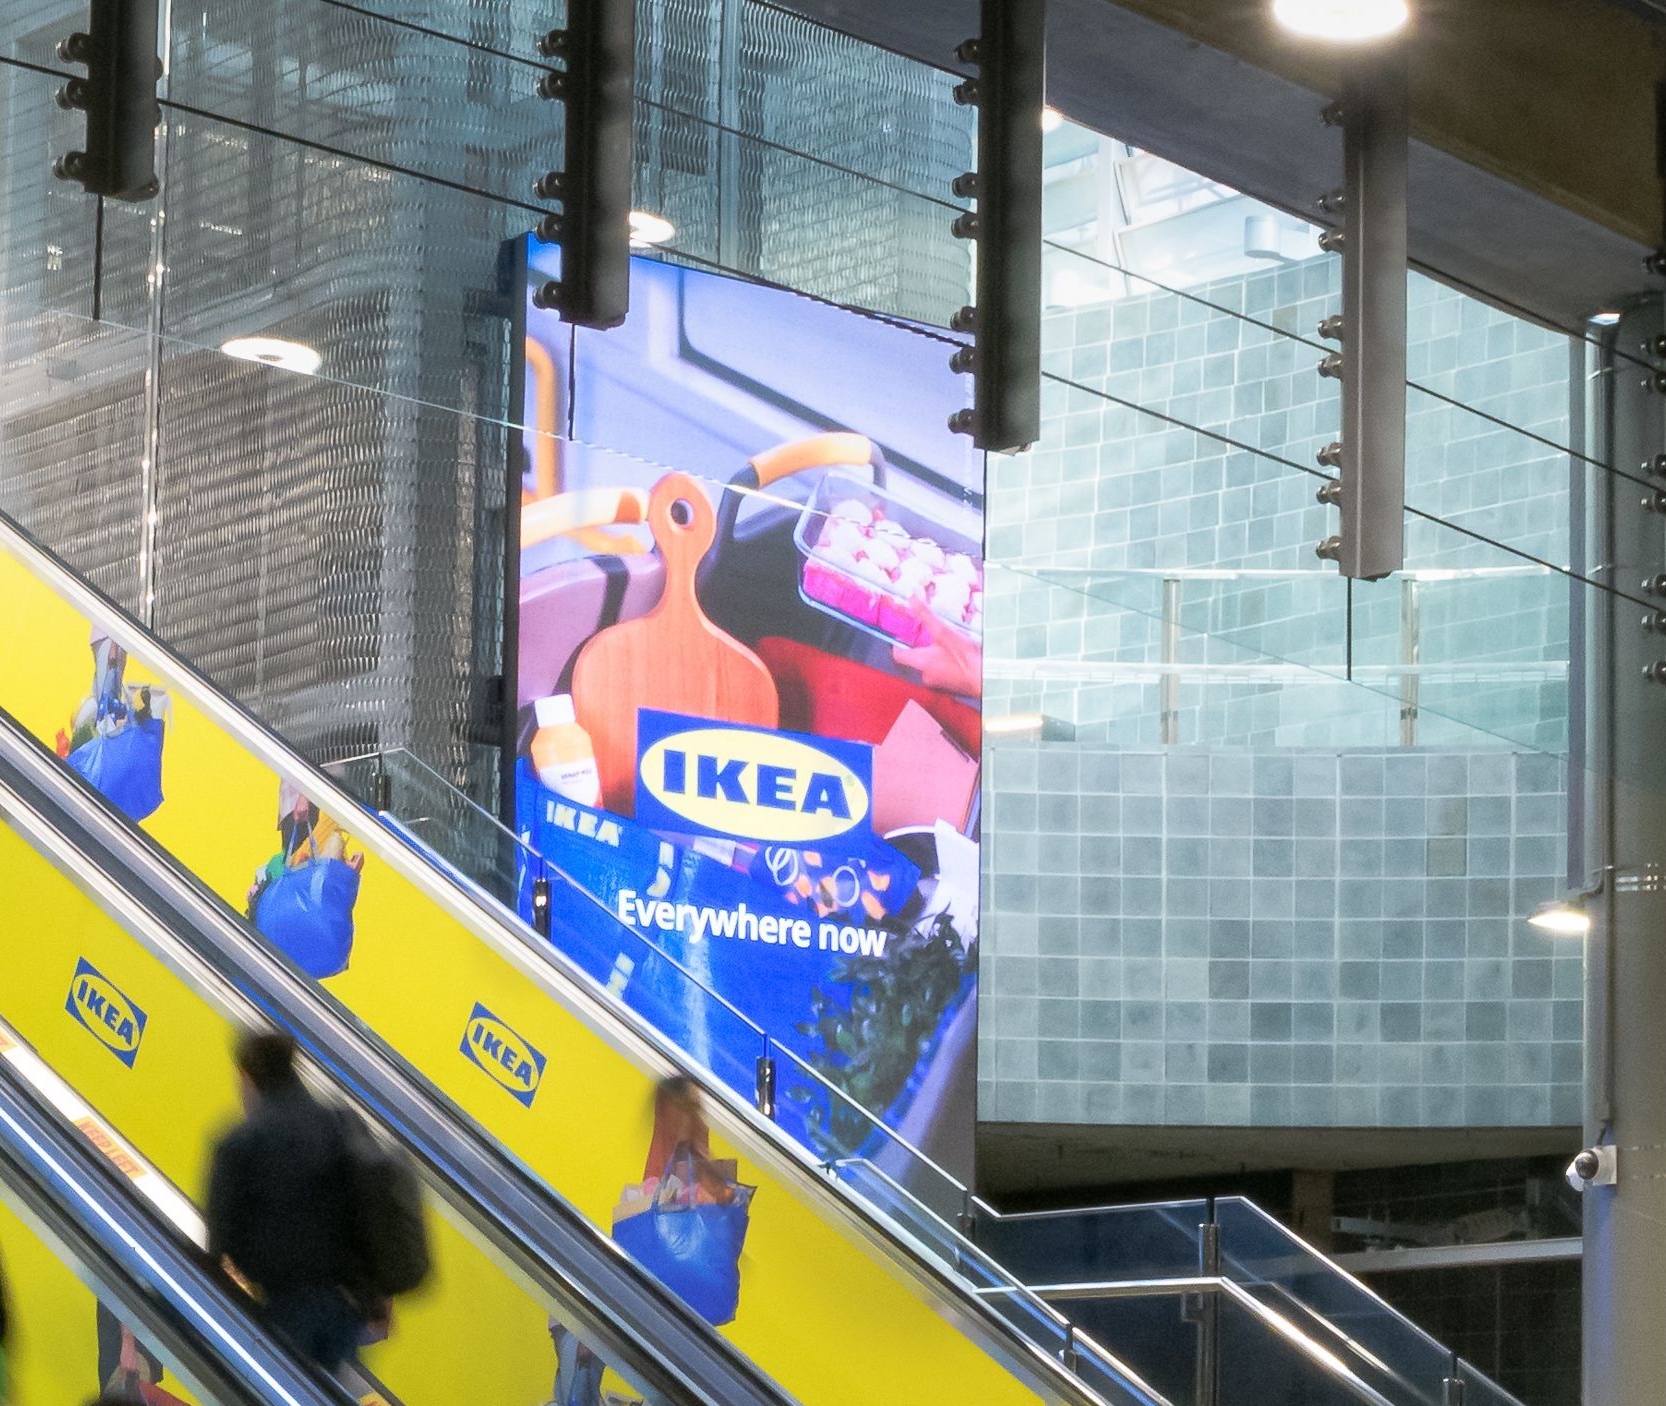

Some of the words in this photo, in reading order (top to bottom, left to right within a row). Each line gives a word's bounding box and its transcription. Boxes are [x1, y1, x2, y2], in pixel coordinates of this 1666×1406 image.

[664, 748, 851, 820] IKEA
[546, 799, 620, 848] IKEA
[618, 889, 812, 949] Everywhere
[818, 922, 888, 958] now
[76, 978, 134, 1048] IKEA
[471, 1022, 532, 1089] IKEA
[78, 1121, 112, 1148] KEEP
[106, 1147, 139, 1176] LEFT
